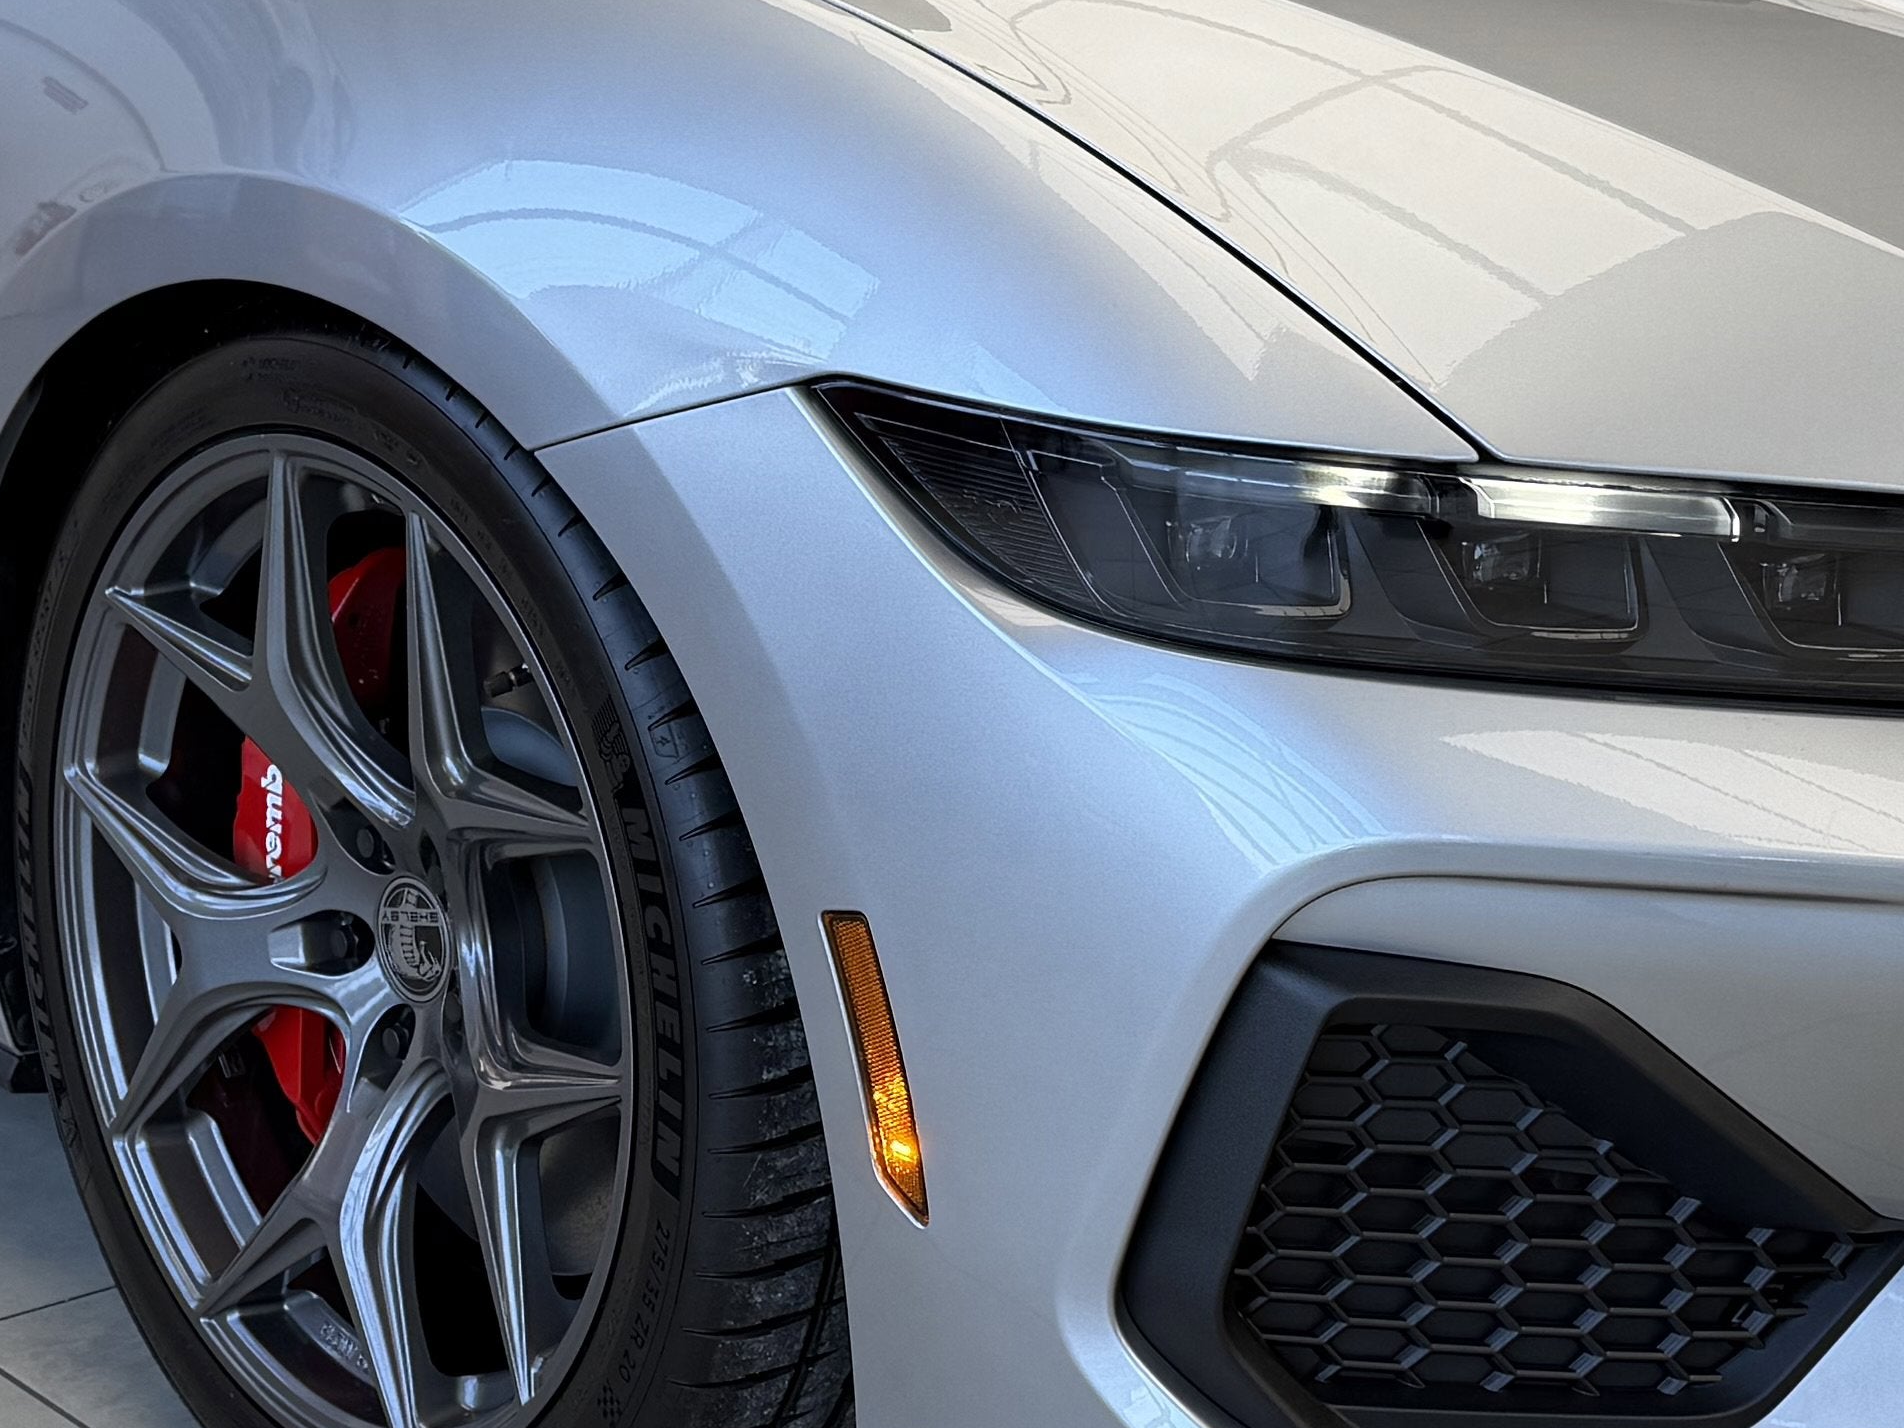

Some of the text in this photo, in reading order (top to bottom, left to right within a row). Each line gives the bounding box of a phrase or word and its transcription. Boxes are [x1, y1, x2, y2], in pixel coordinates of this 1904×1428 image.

[260, 763, 284, 883] remb
[382, 910, 439, 924] SHELBY
[620, 804, 682, 1184] MICHELIN
